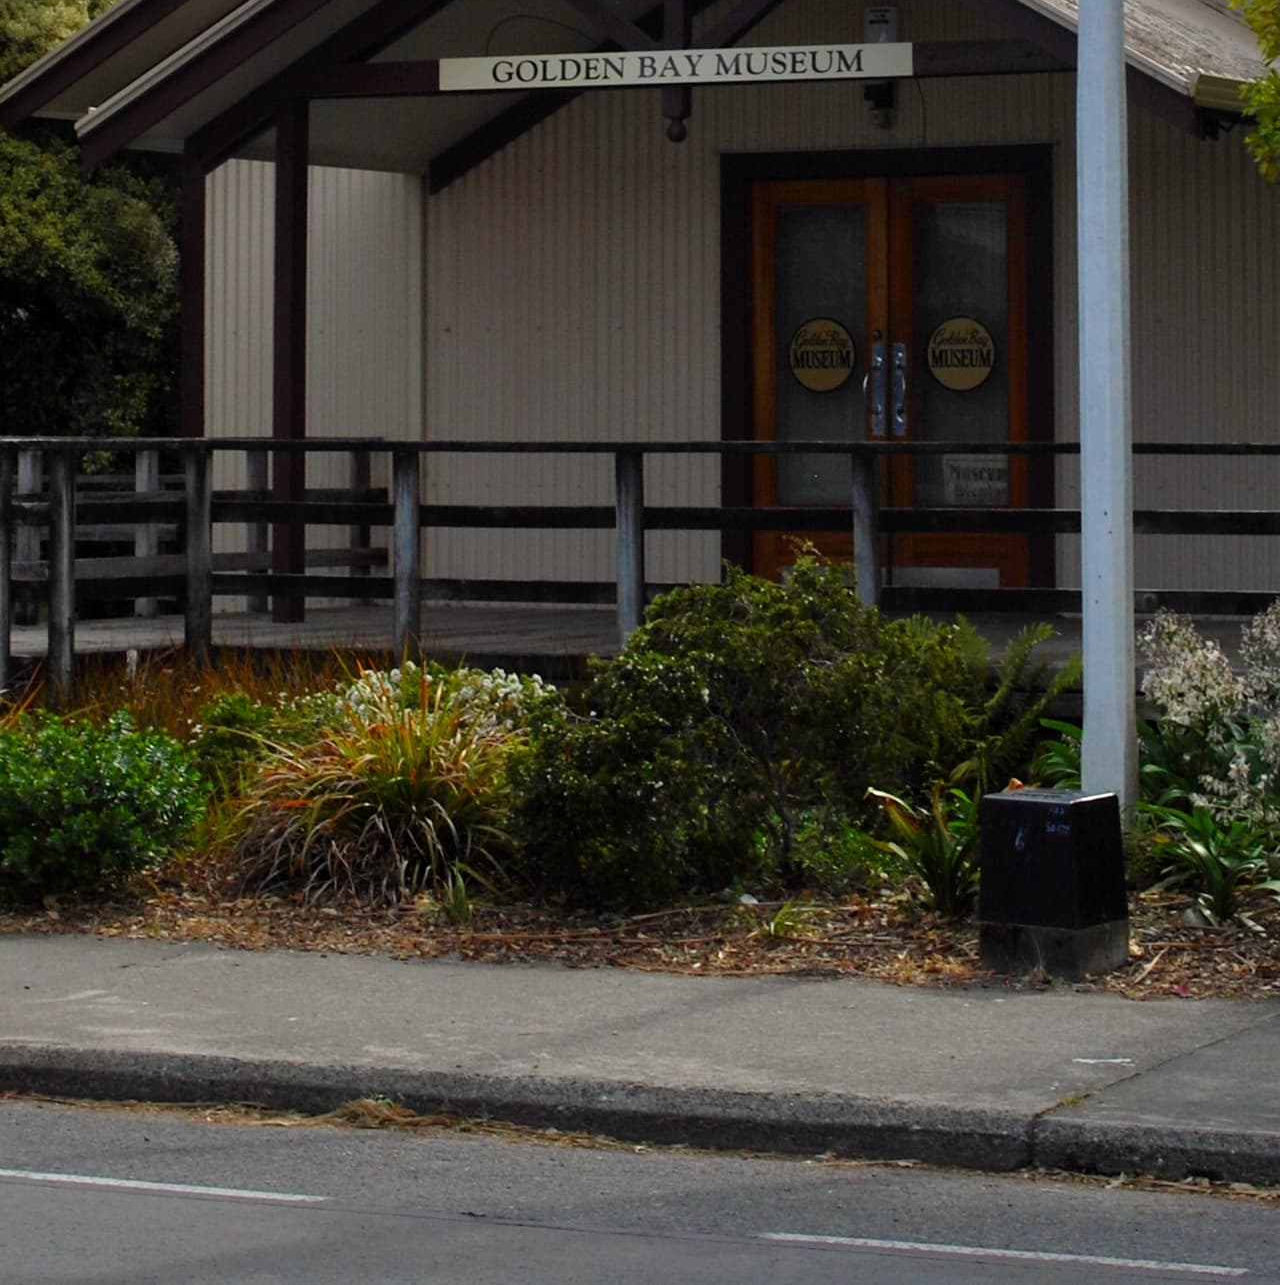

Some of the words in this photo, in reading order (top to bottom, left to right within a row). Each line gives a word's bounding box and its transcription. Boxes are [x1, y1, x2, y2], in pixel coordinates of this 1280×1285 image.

[491, 57, 625, 83] GOLDEN
[638, 55, 704, 79] BAY
[715, 49, 864, 76] MUSEUM
[932, 327, 967, 347] Golden
[968, 328, 989, 348] Bay
[793, 348, 851, 369] MUSEUM
[931, 348, 991, 368] MUSEUM
